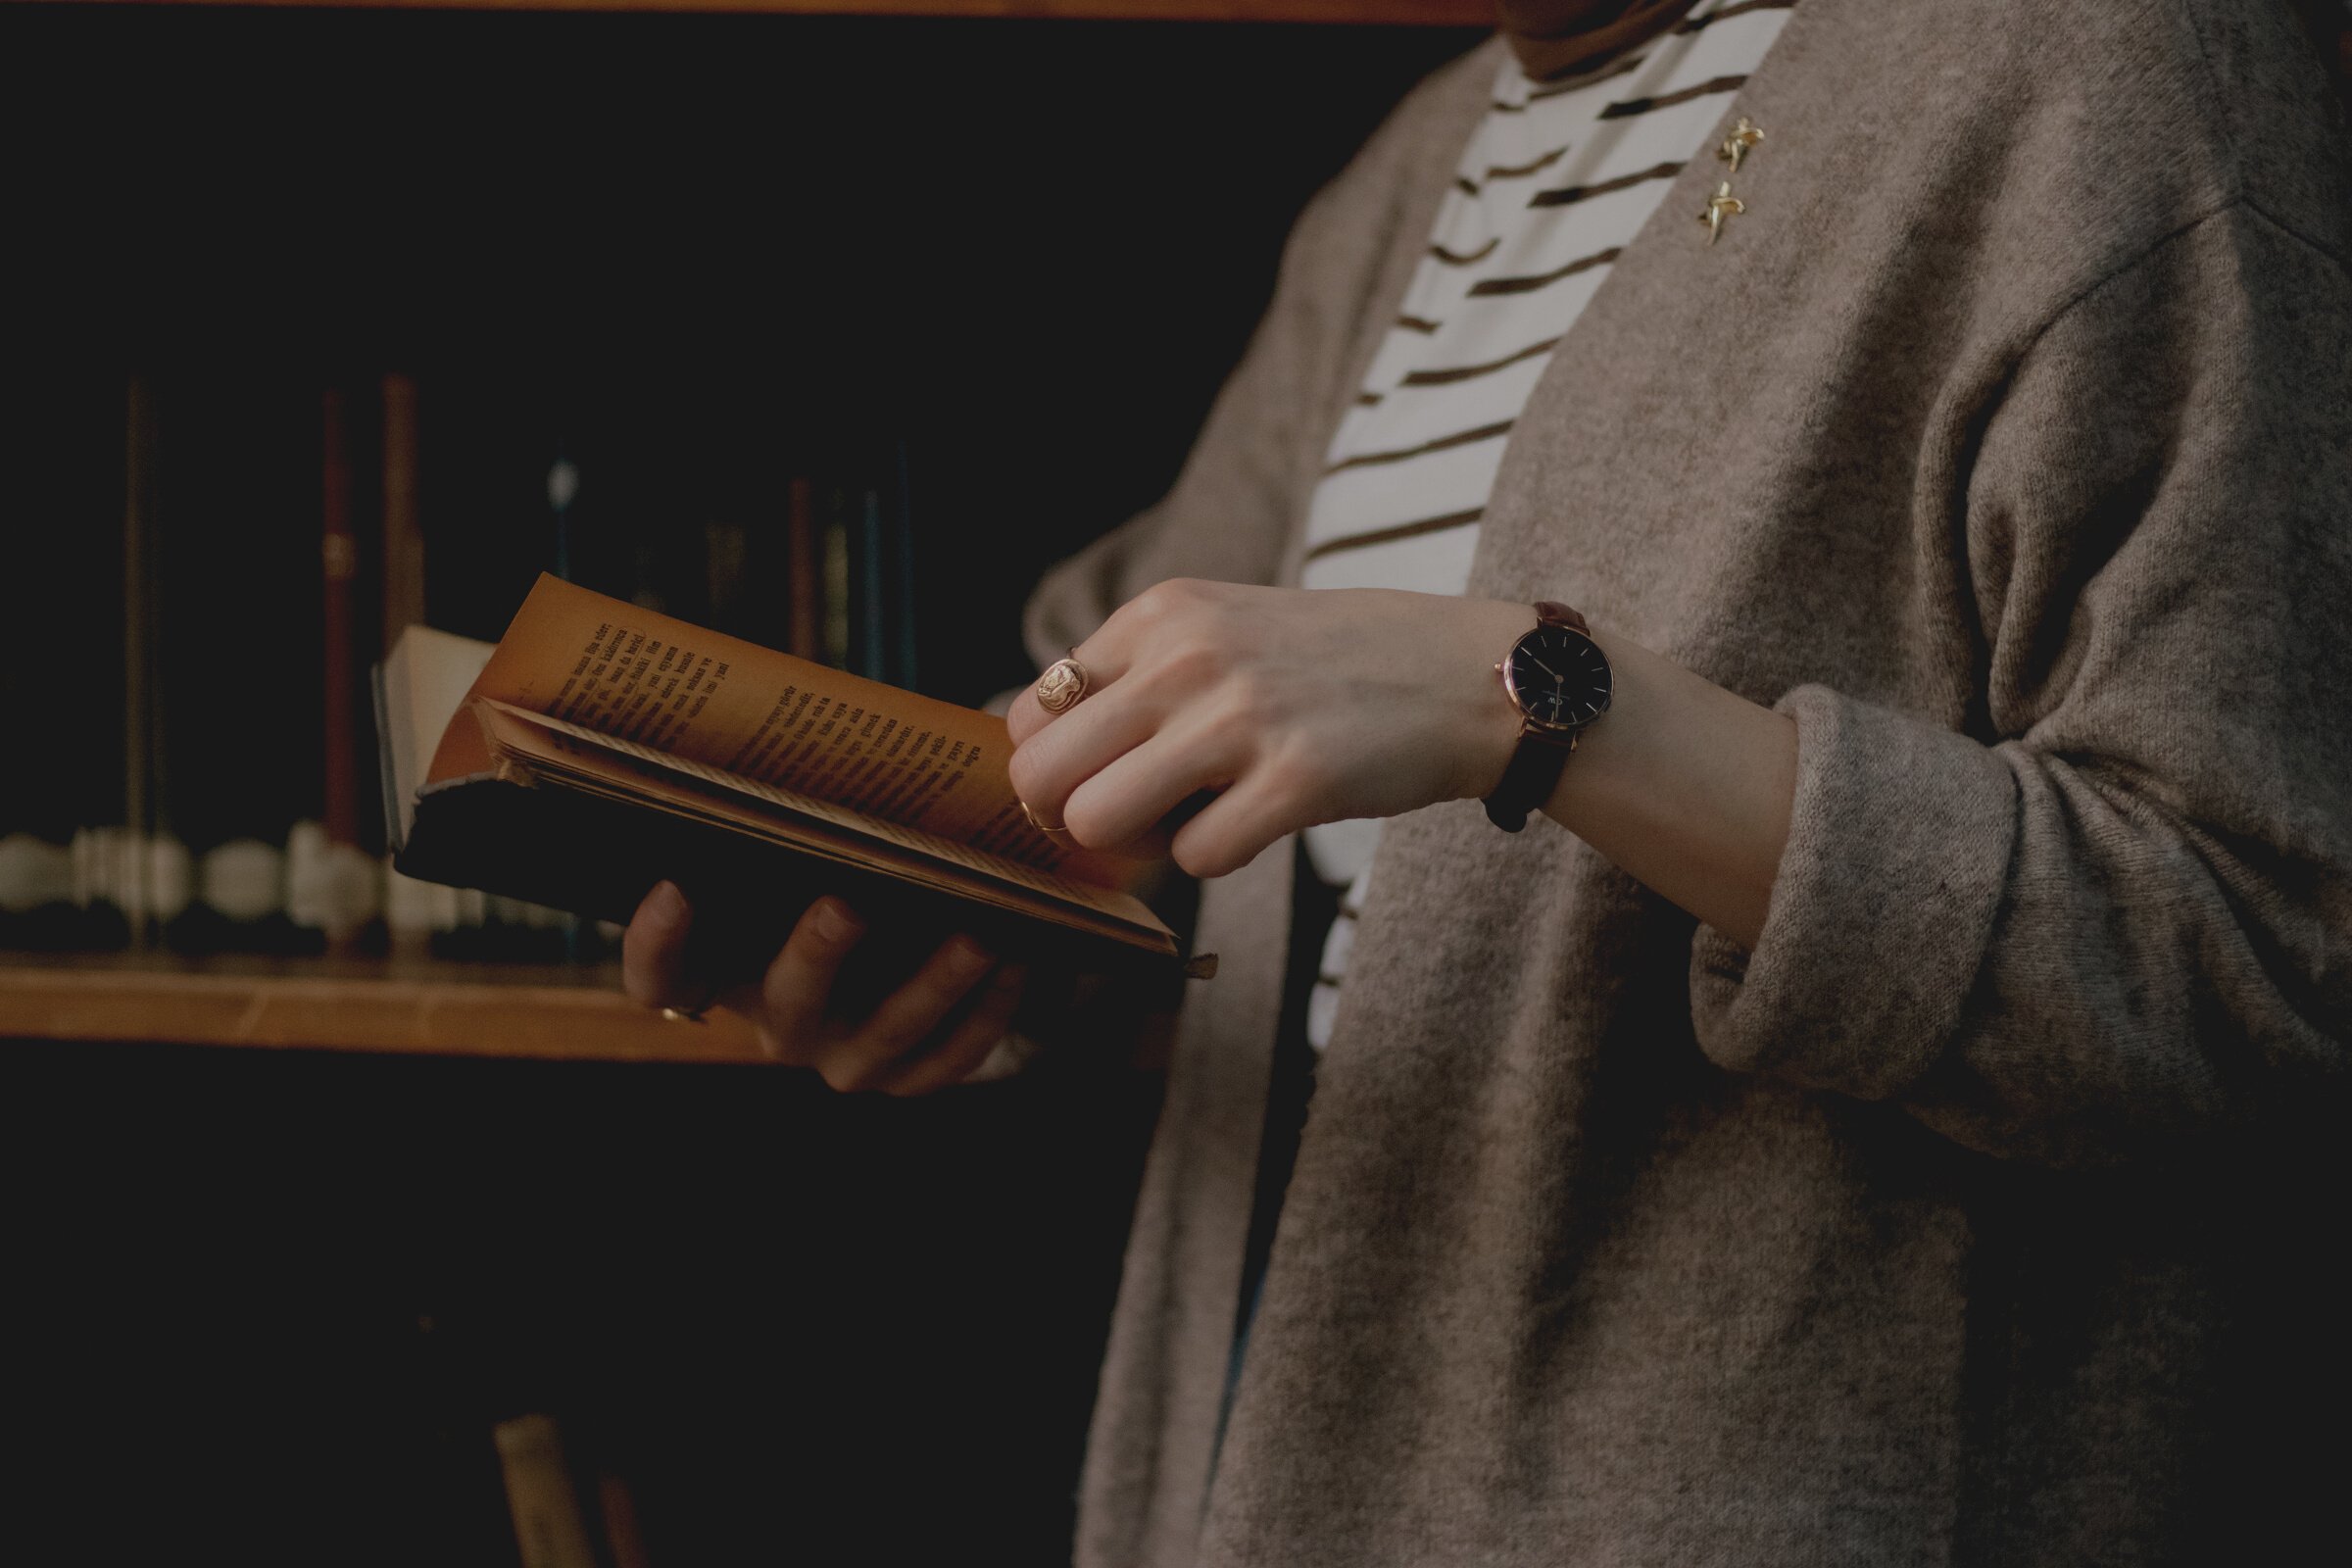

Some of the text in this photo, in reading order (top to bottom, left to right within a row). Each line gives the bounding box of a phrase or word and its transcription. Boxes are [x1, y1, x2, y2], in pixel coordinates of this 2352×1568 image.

[596, 623, 612, 640] eder;
[687, 667, 706, 690] noksan
[714, 662, 730, 679] yani
[780, 685, 797, 706] görür
[860, 713, 881, 737] gitmek
[962, 746, 981, 766] doğru
